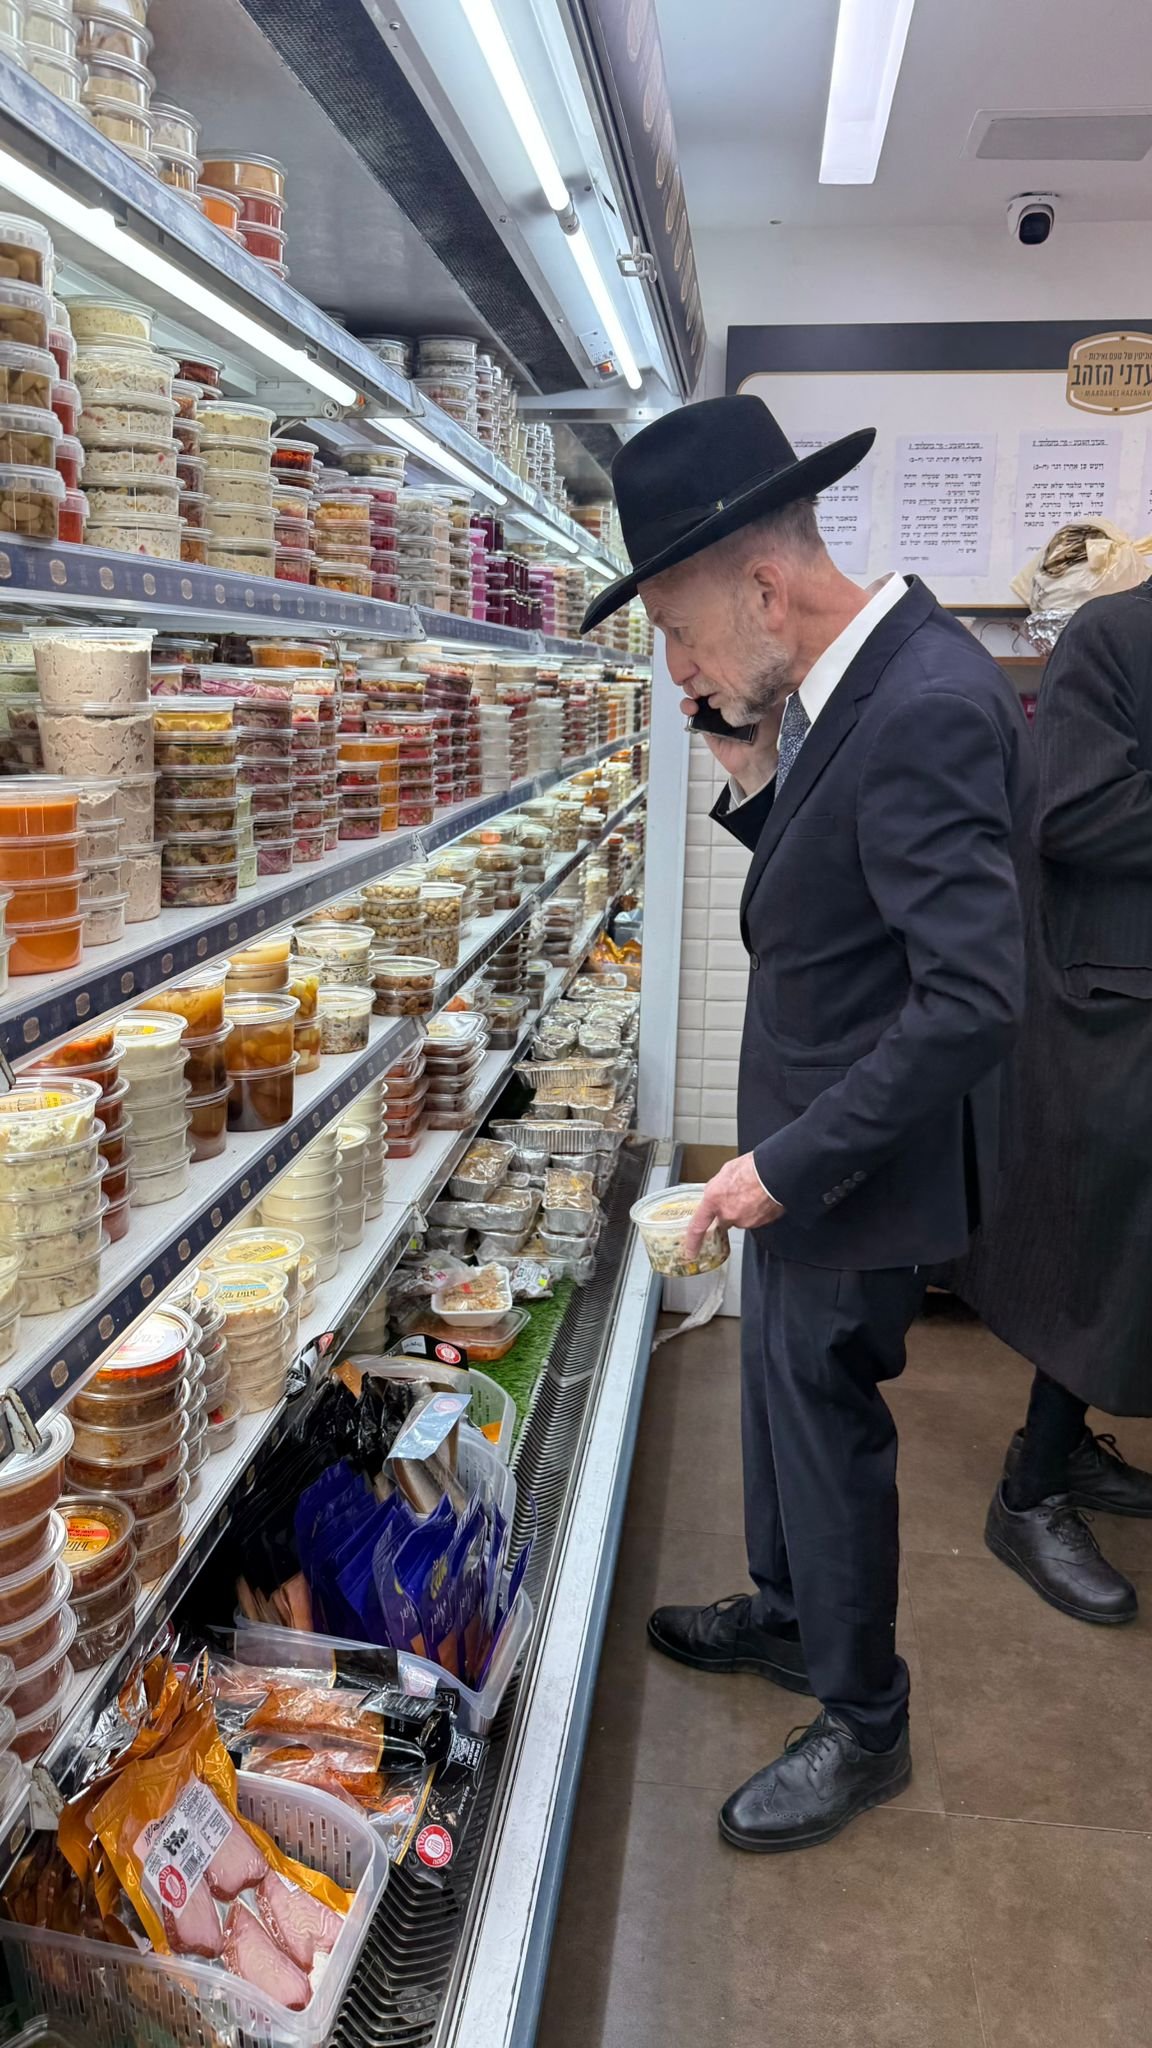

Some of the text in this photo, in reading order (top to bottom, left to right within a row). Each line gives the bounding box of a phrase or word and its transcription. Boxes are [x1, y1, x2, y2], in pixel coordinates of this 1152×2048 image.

[1109, 352, 1122, 361] טעם
[1124, 352, 1132, 361] של
[1071, 364, 1114, 386] הזהב
